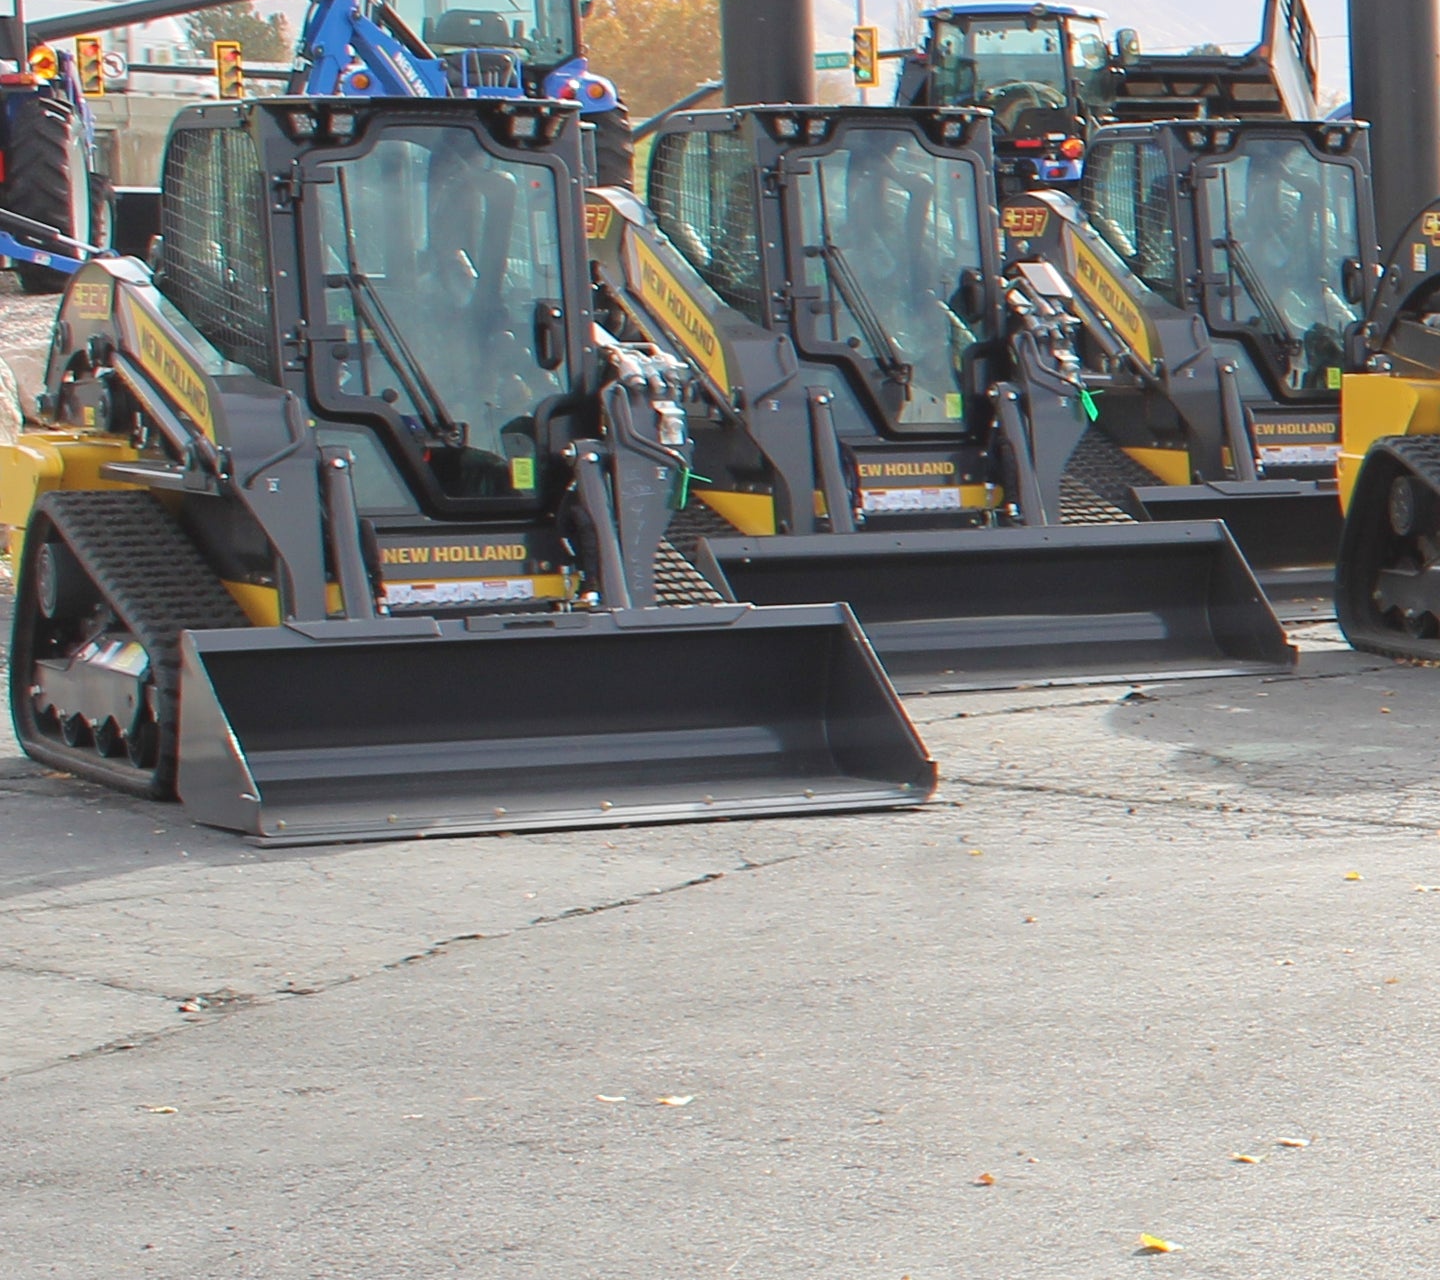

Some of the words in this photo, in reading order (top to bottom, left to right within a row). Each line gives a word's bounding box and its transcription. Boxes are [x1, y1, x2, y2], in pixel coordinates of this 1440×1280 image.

[643, 259, 668, 301] NEW
[667, 289, 716, 357] HOLLAND
[1077, 252, 1099, 289] NEW
[1098, 282, 1139, 333] HOLLAND
[164, 358, 208, 417] HOLLAND
[1255, 424, 1275, 435] EW
[1277, 422, 1336, 434] HOLLAND
[859, 464, 882, 477] EW
[885, 462, 954, 476] HOLLAND
[383, 547, 430, 564] NEW
[433, 545, 527, 563] HOLLAND
